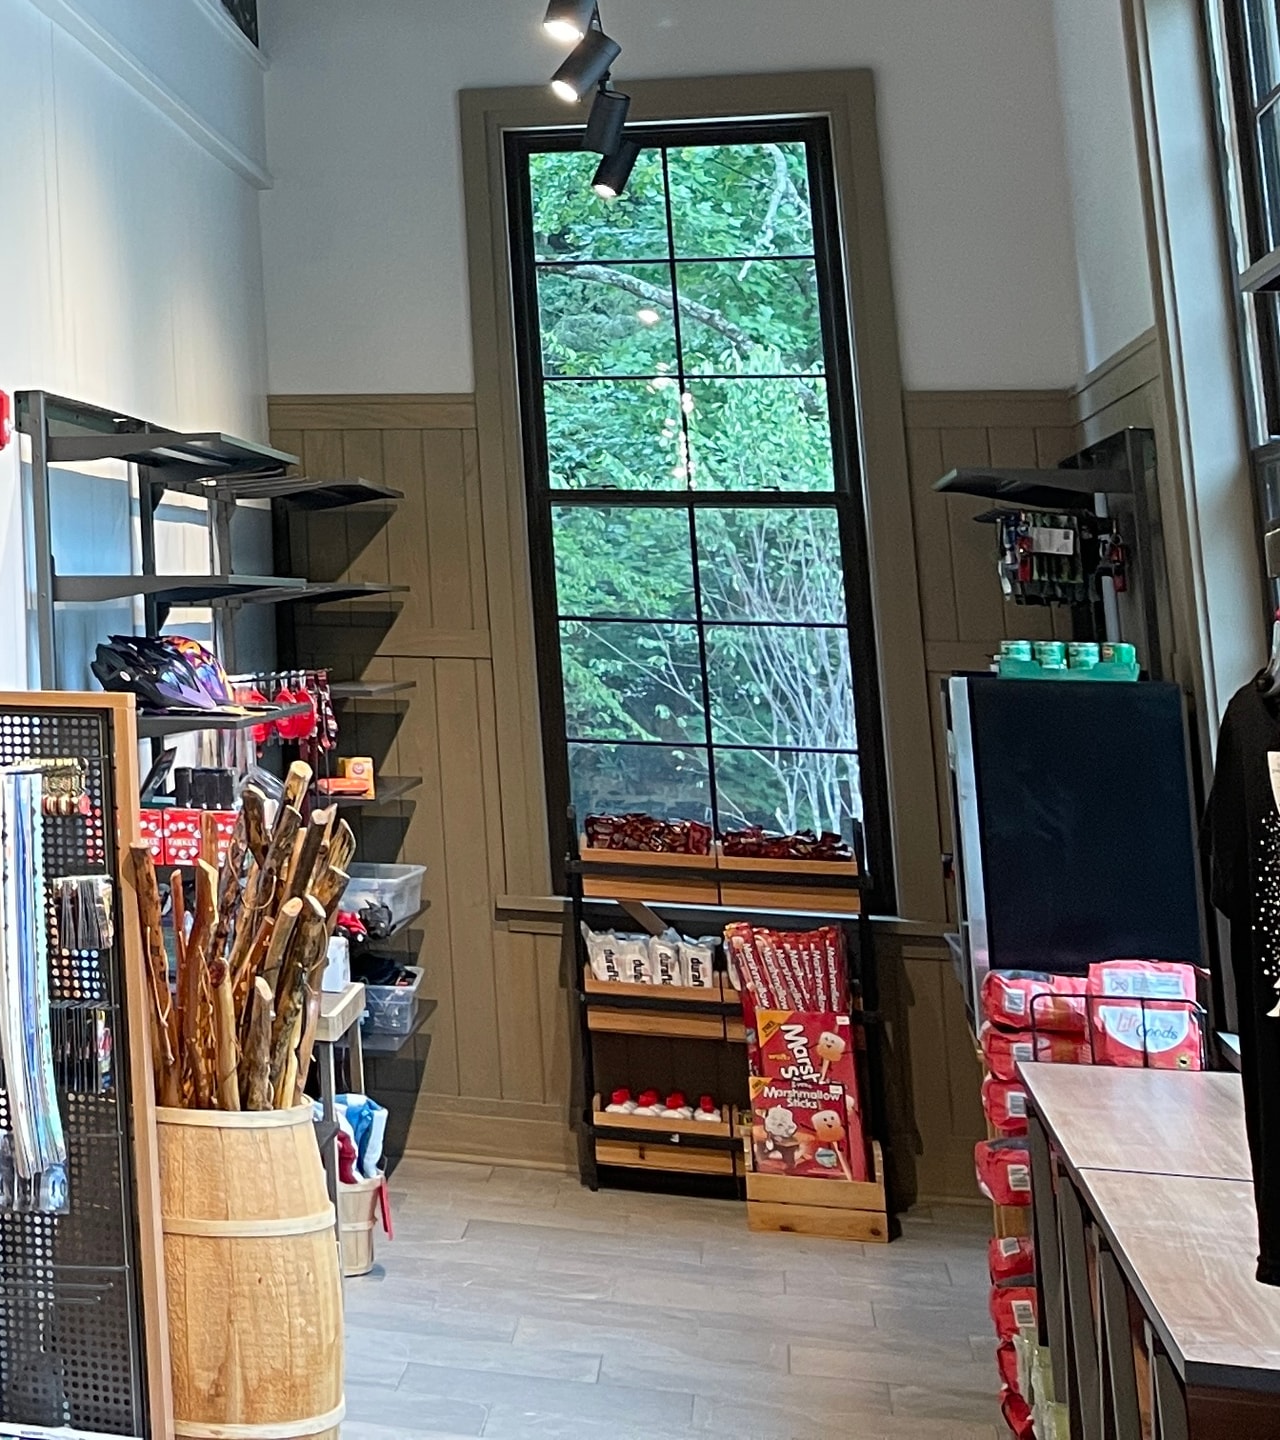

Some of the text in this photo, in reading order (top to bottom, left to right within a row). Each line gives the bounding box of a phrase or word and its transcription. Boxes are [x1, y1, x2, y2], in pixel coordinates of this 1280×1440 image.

[742, 942, 770, 1009] Marshmallow
[763, 1086, 841, 1102] Marshmallow
[786, 1097, 819, 1109] Sticks
